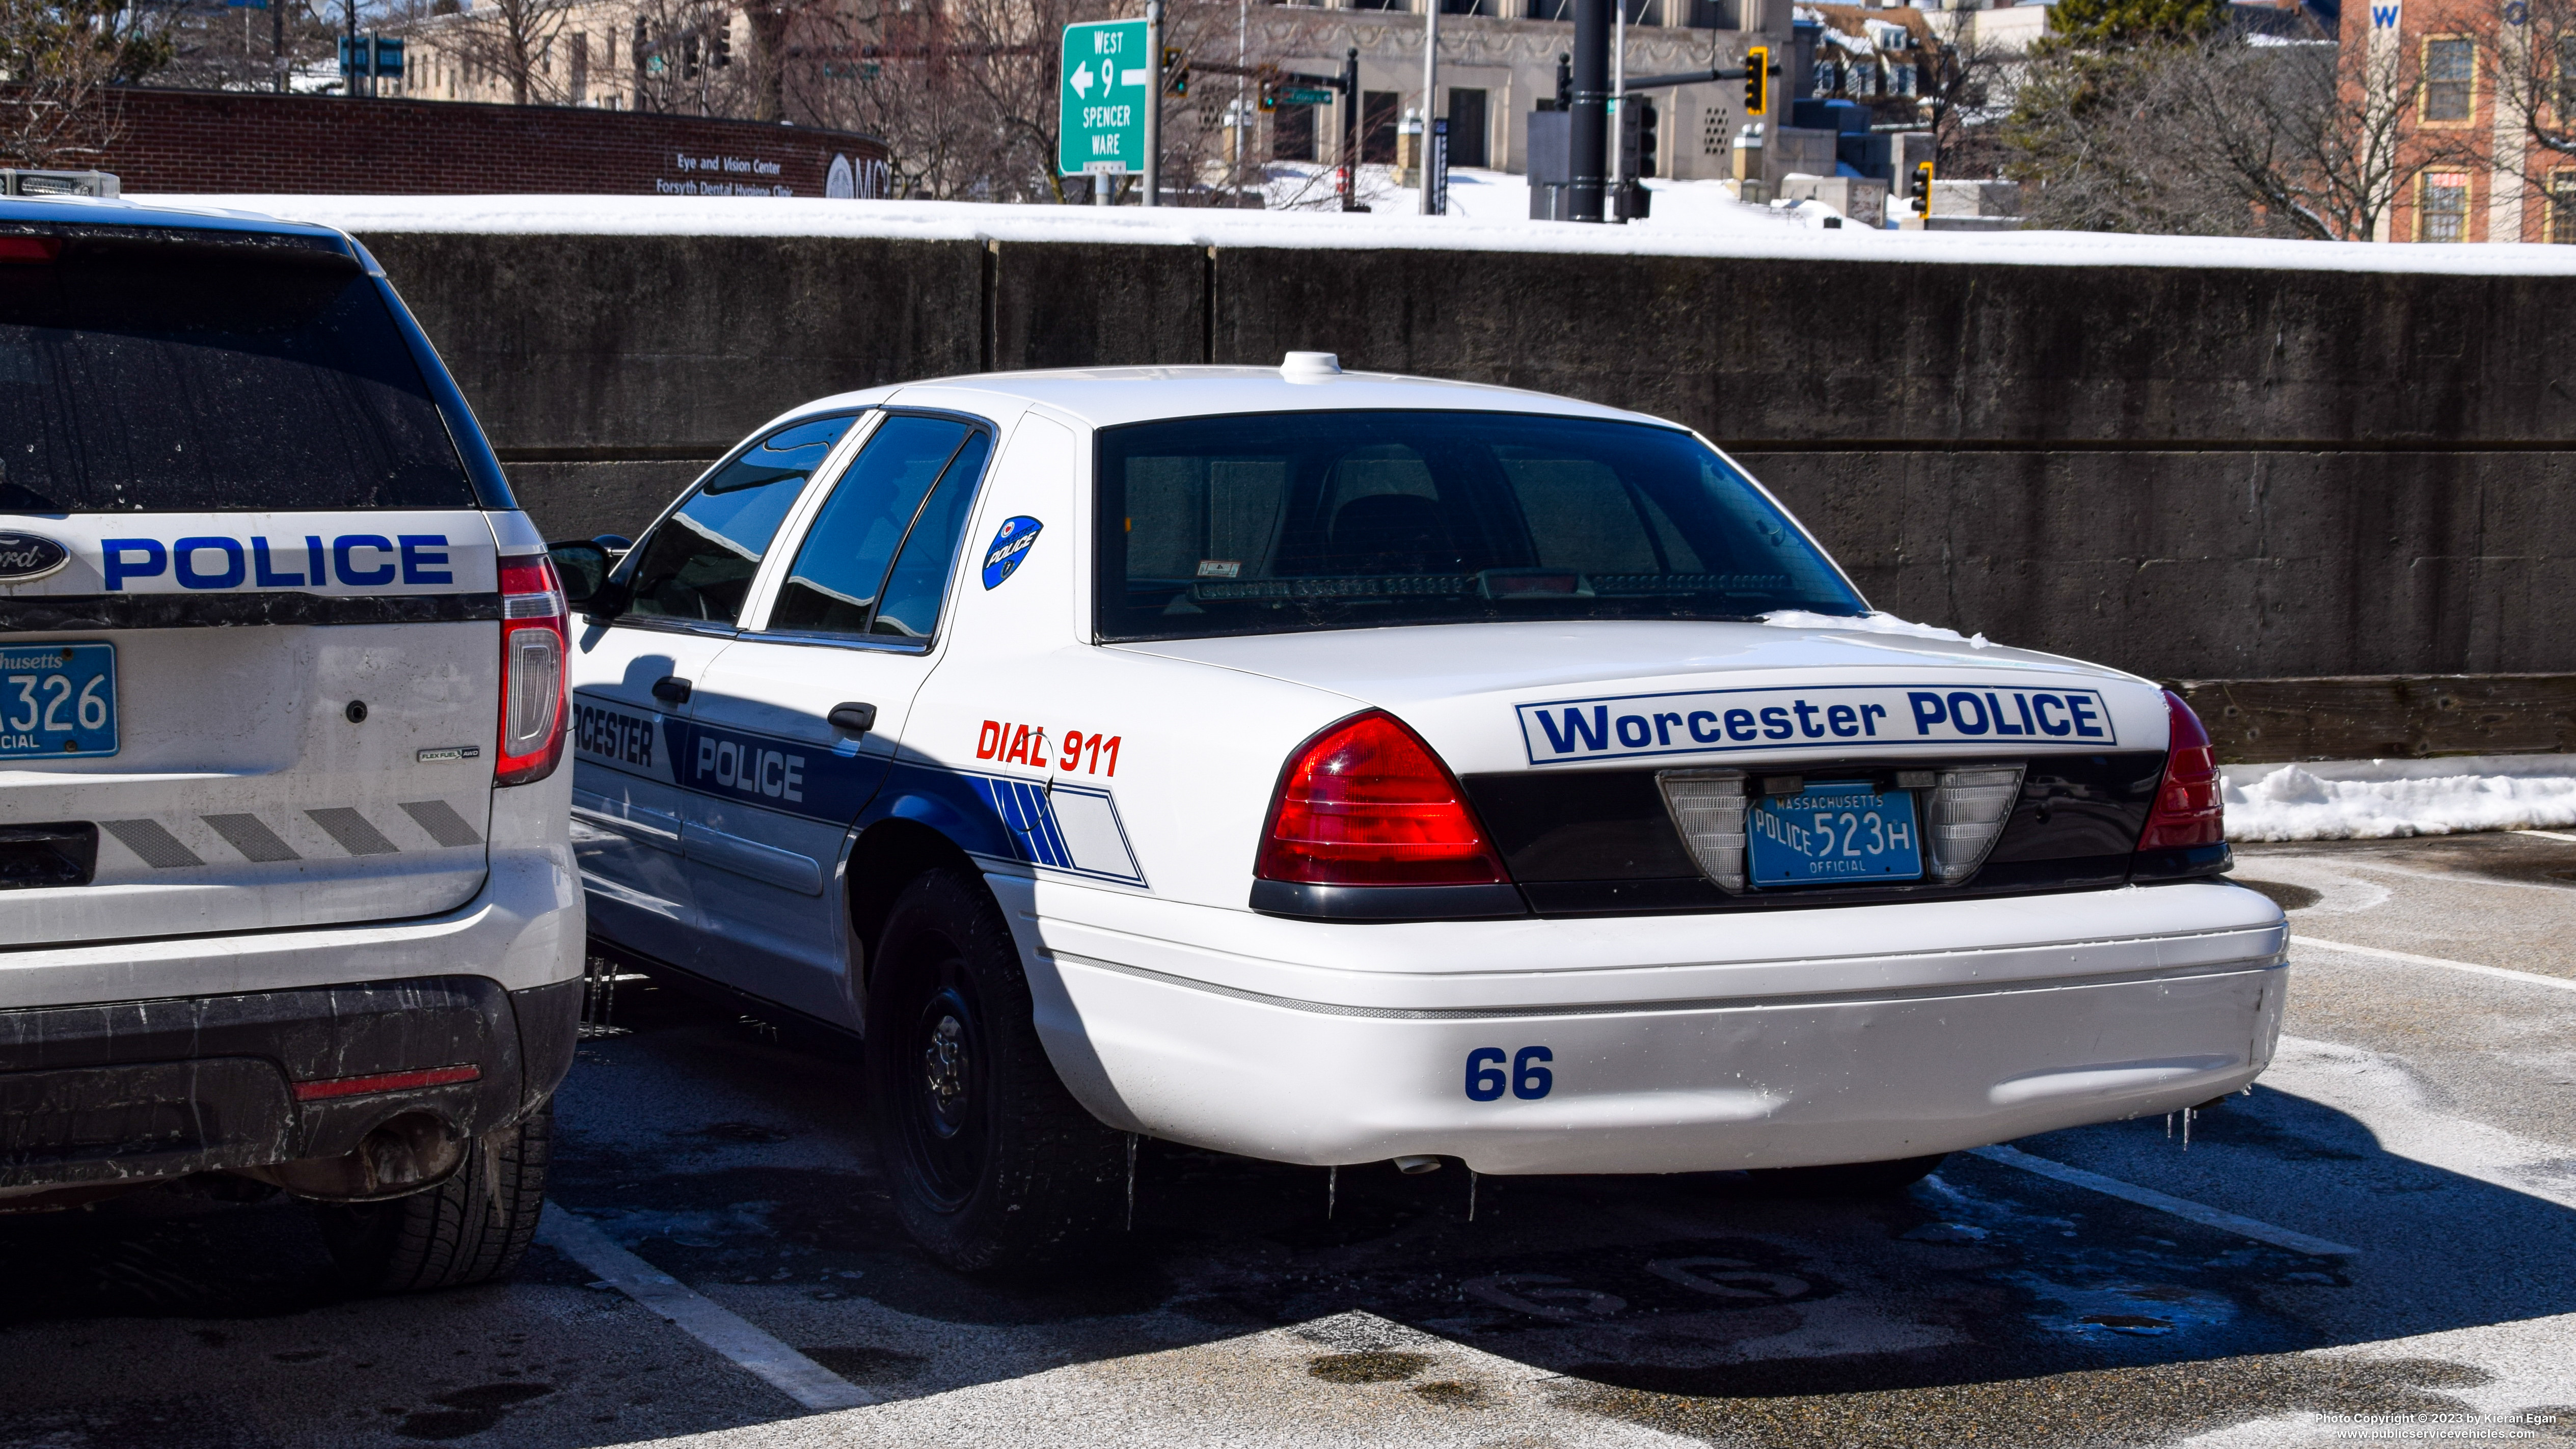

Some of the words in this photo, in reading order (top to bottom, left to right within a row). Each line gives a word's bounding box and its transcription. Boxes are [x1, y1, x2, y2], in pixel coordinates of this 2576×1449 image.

[2373, 6, 2398, 28] W
[1094, 31, 1123, 54] WEST
[1101, 58, 1114, 99] 9
[1083, 105, 1130, 128] SPENCER
[1092, 133, 1120, 155] WARE
[677, 154, 696, 172] Eye
[700, 155, 719, 171] and
[724, 156, 750, 173] Vision
[753, 158, 780, 175] Center
[657, 178, 697, 196] Forsyth
[700, 181, 732, 196] Dental
[100, 534, 453, 591] POLICE
[986, 530, 1037, 568] POLICE
[0, 673, 106, 732] 326
[1534, 699, 1887, 754] Worcester
[1907, 692, 2103, 736] POLICE
[976, 720, 1047, 768] DIAL
[1060, 730, 1122, 777] 911
[697, 736, 805, 803] POLICE
[1776, 795, 1883, 810] MASSACHUSETTS
[1755, 809, 1812, 857] POLICE
[1809, 860, 1866, 873] OFFICIAL
[1465, 1046, 1553, 1102] 66
